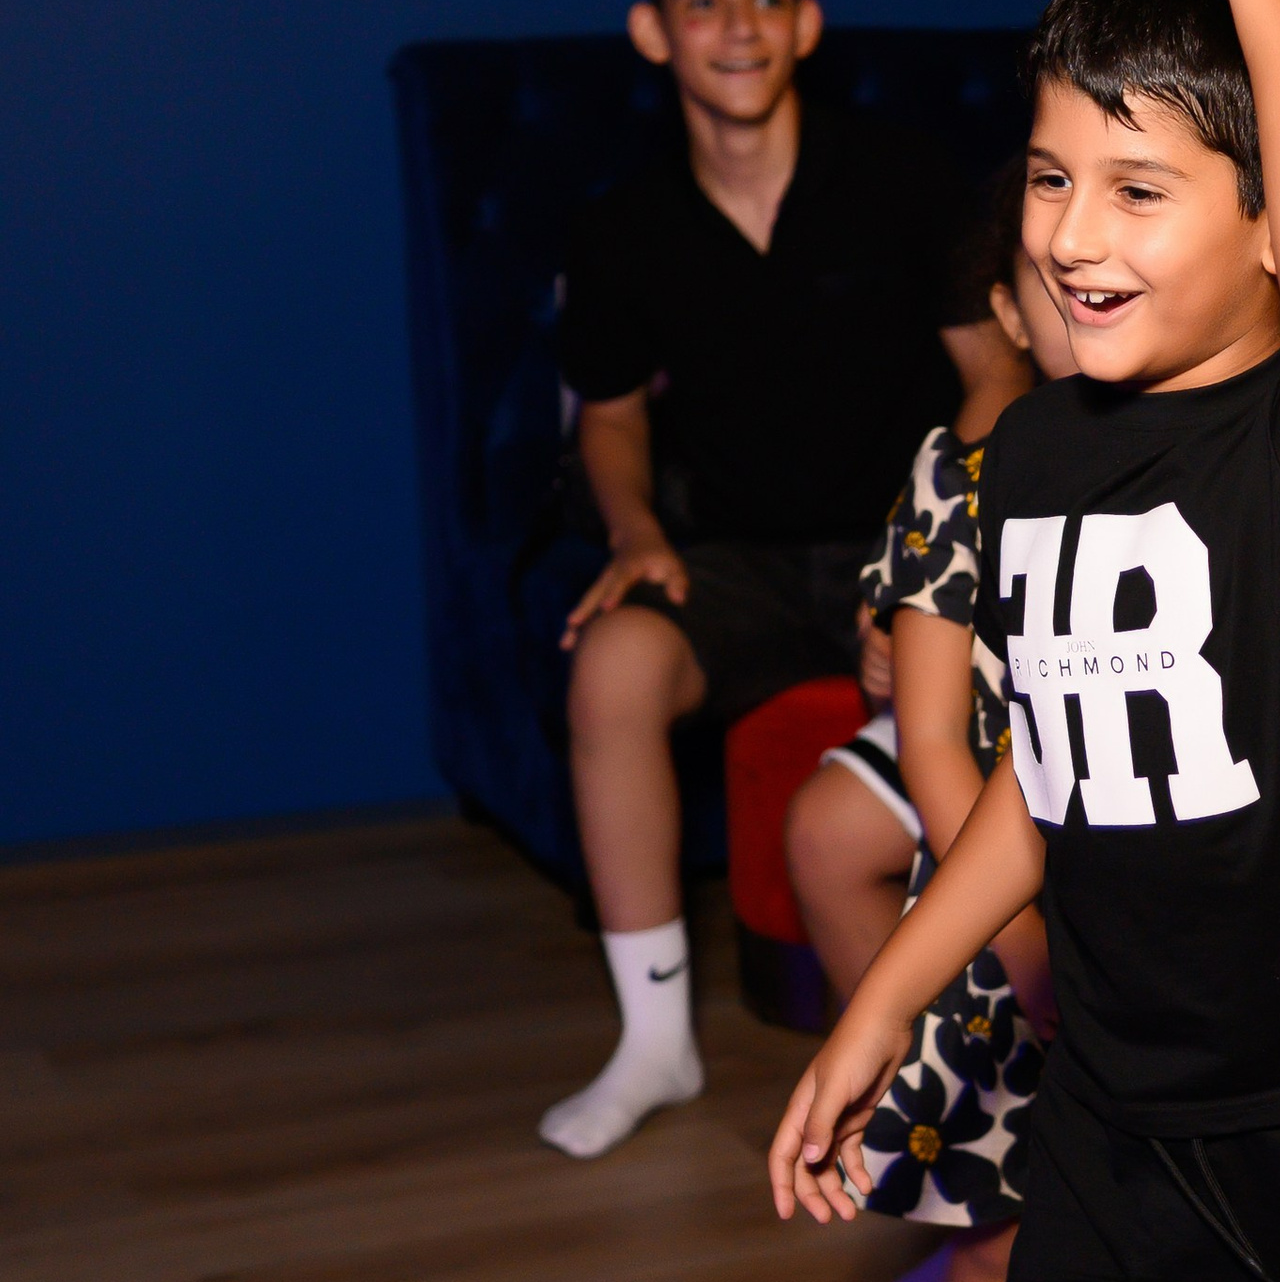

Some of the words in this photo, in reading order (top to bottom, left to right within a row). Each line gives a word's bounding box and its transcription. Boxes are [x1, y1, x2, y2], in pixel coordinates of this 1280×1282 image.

[1066, 640, 1096, 654] JOHN
[1000, 502, 1261, 826] JR
[1013, 650, 1176, 678] RICHMOND
